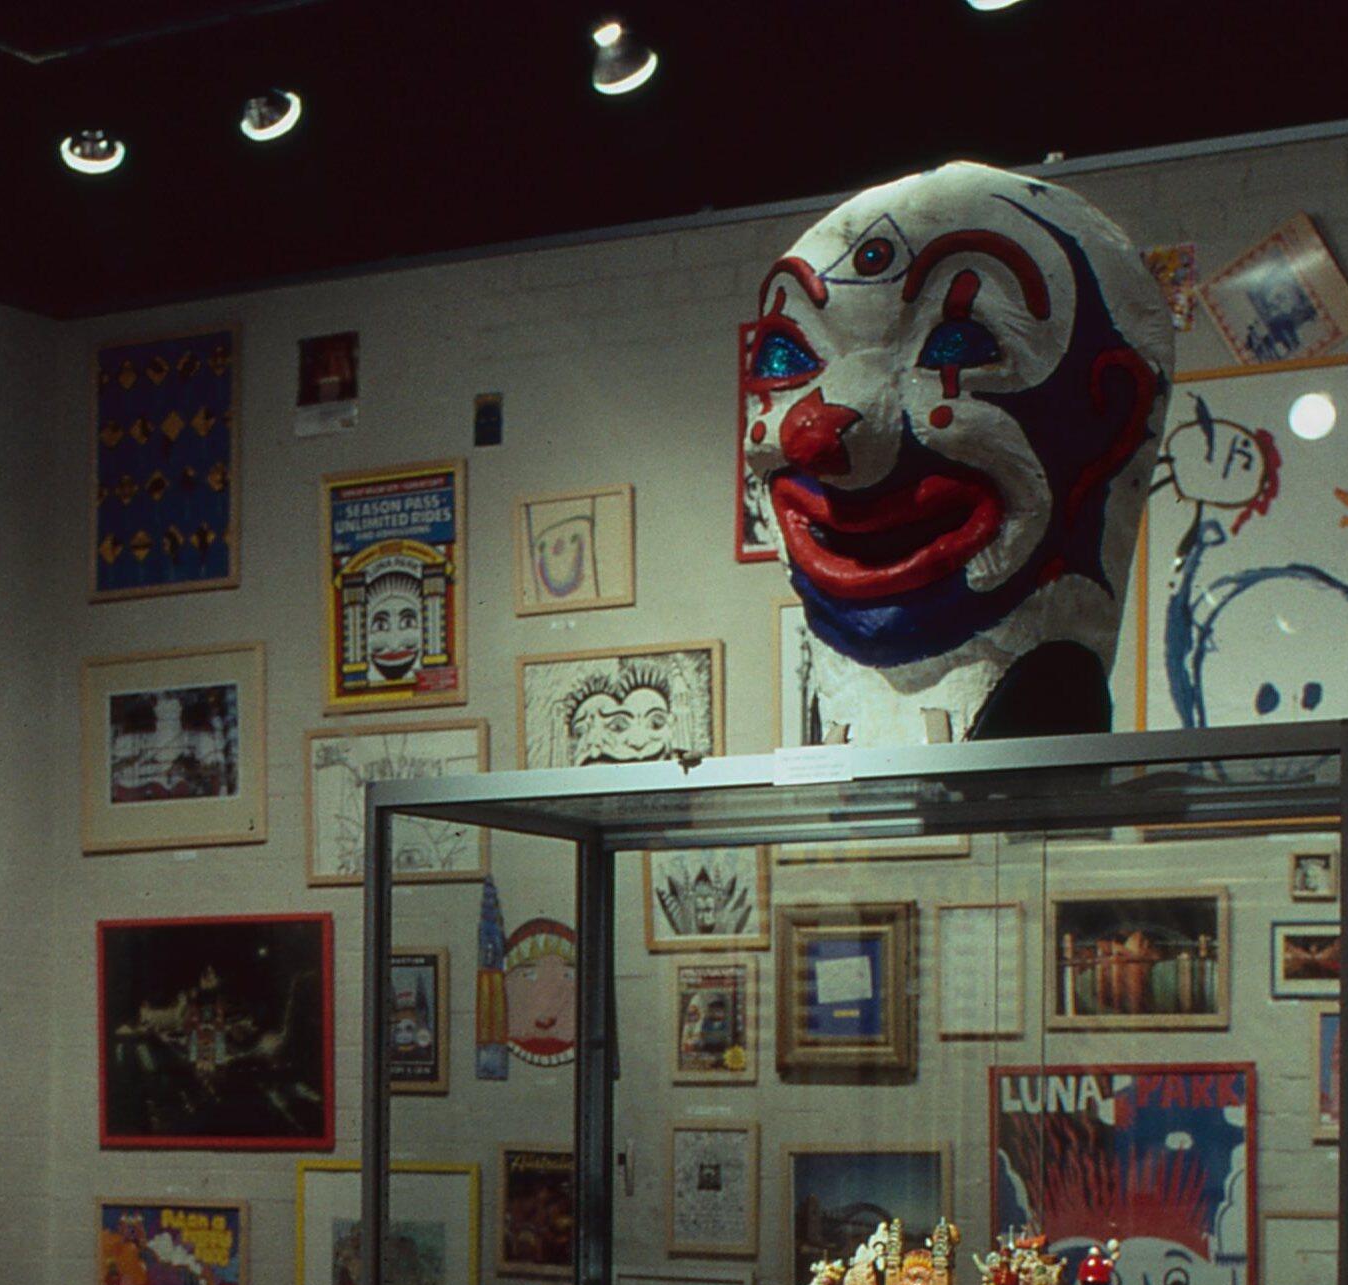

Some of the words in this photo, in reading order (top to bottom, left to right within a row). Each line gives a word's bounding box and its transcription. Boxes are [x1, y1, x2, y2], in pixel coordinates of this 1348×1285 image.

[333, 511, 410, 535] UNLIMITED
[410, 506, 452, 523] RIDES
[343, 498, 403, 519] SEASON
[404, 493, 441, 514] PASS
[1001, 1074, 1102, 1114] LUNA
[1136, 1073, 1240, 1110] PARK
